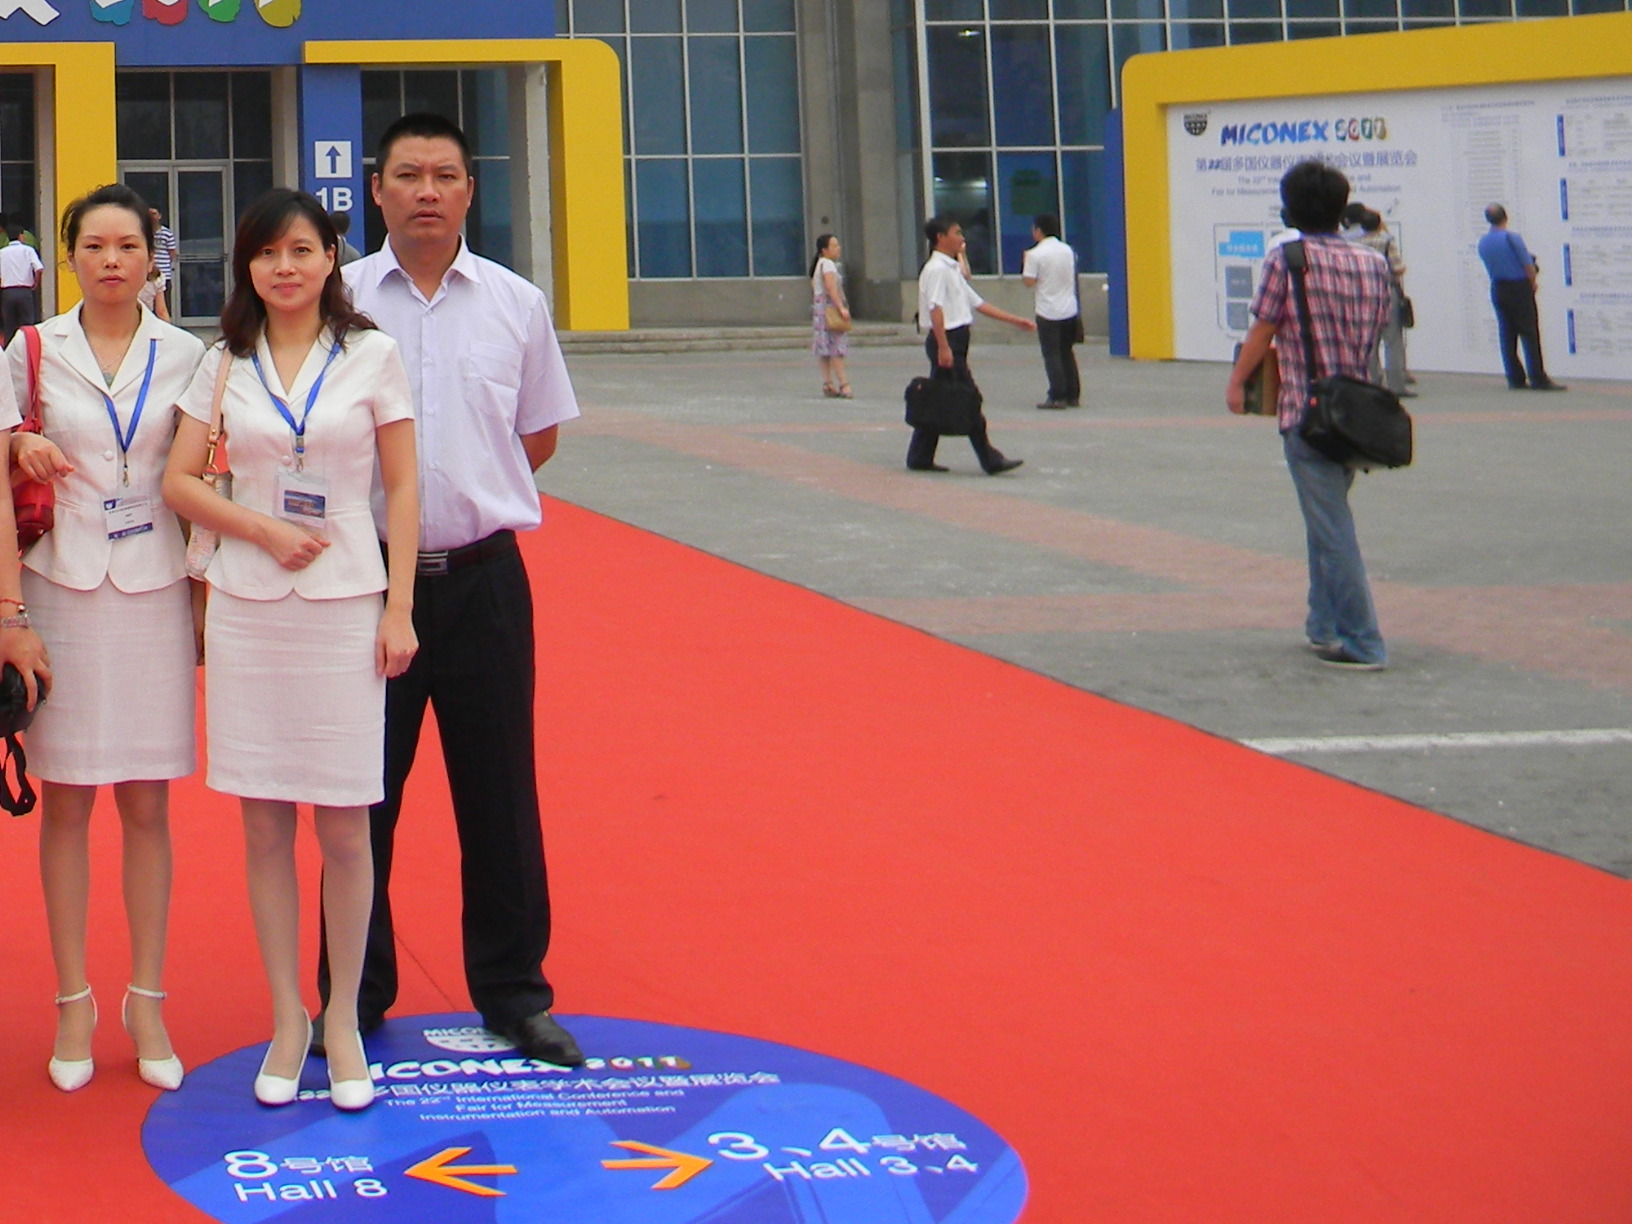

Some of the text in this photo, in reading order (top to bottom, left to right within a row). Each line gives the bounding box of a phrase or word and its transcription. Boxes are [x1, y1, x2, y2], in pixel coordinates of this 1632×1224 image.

[1221, 120, 1329, 147] MICONEX
[315, 187, 353, 212] 1B
[368, 1056, 679, 1081] ICONEX 2011
[386, 1097, 416, 1107] The
[456, 1092, 554, 1104] International
[557, 1089, 650, 1100] Conference
[654, 1088, 685, 1097] and
[455, 1098, 627, 1112] Fair for Measurement
[420, 1104, 677, 1121] Instrumentation and Automation
[224, 1150, 374, 1179] 8号馆
[762, 1157, 871, 1180] Hall
[234, 1178, 388, 1202] Hall 8
